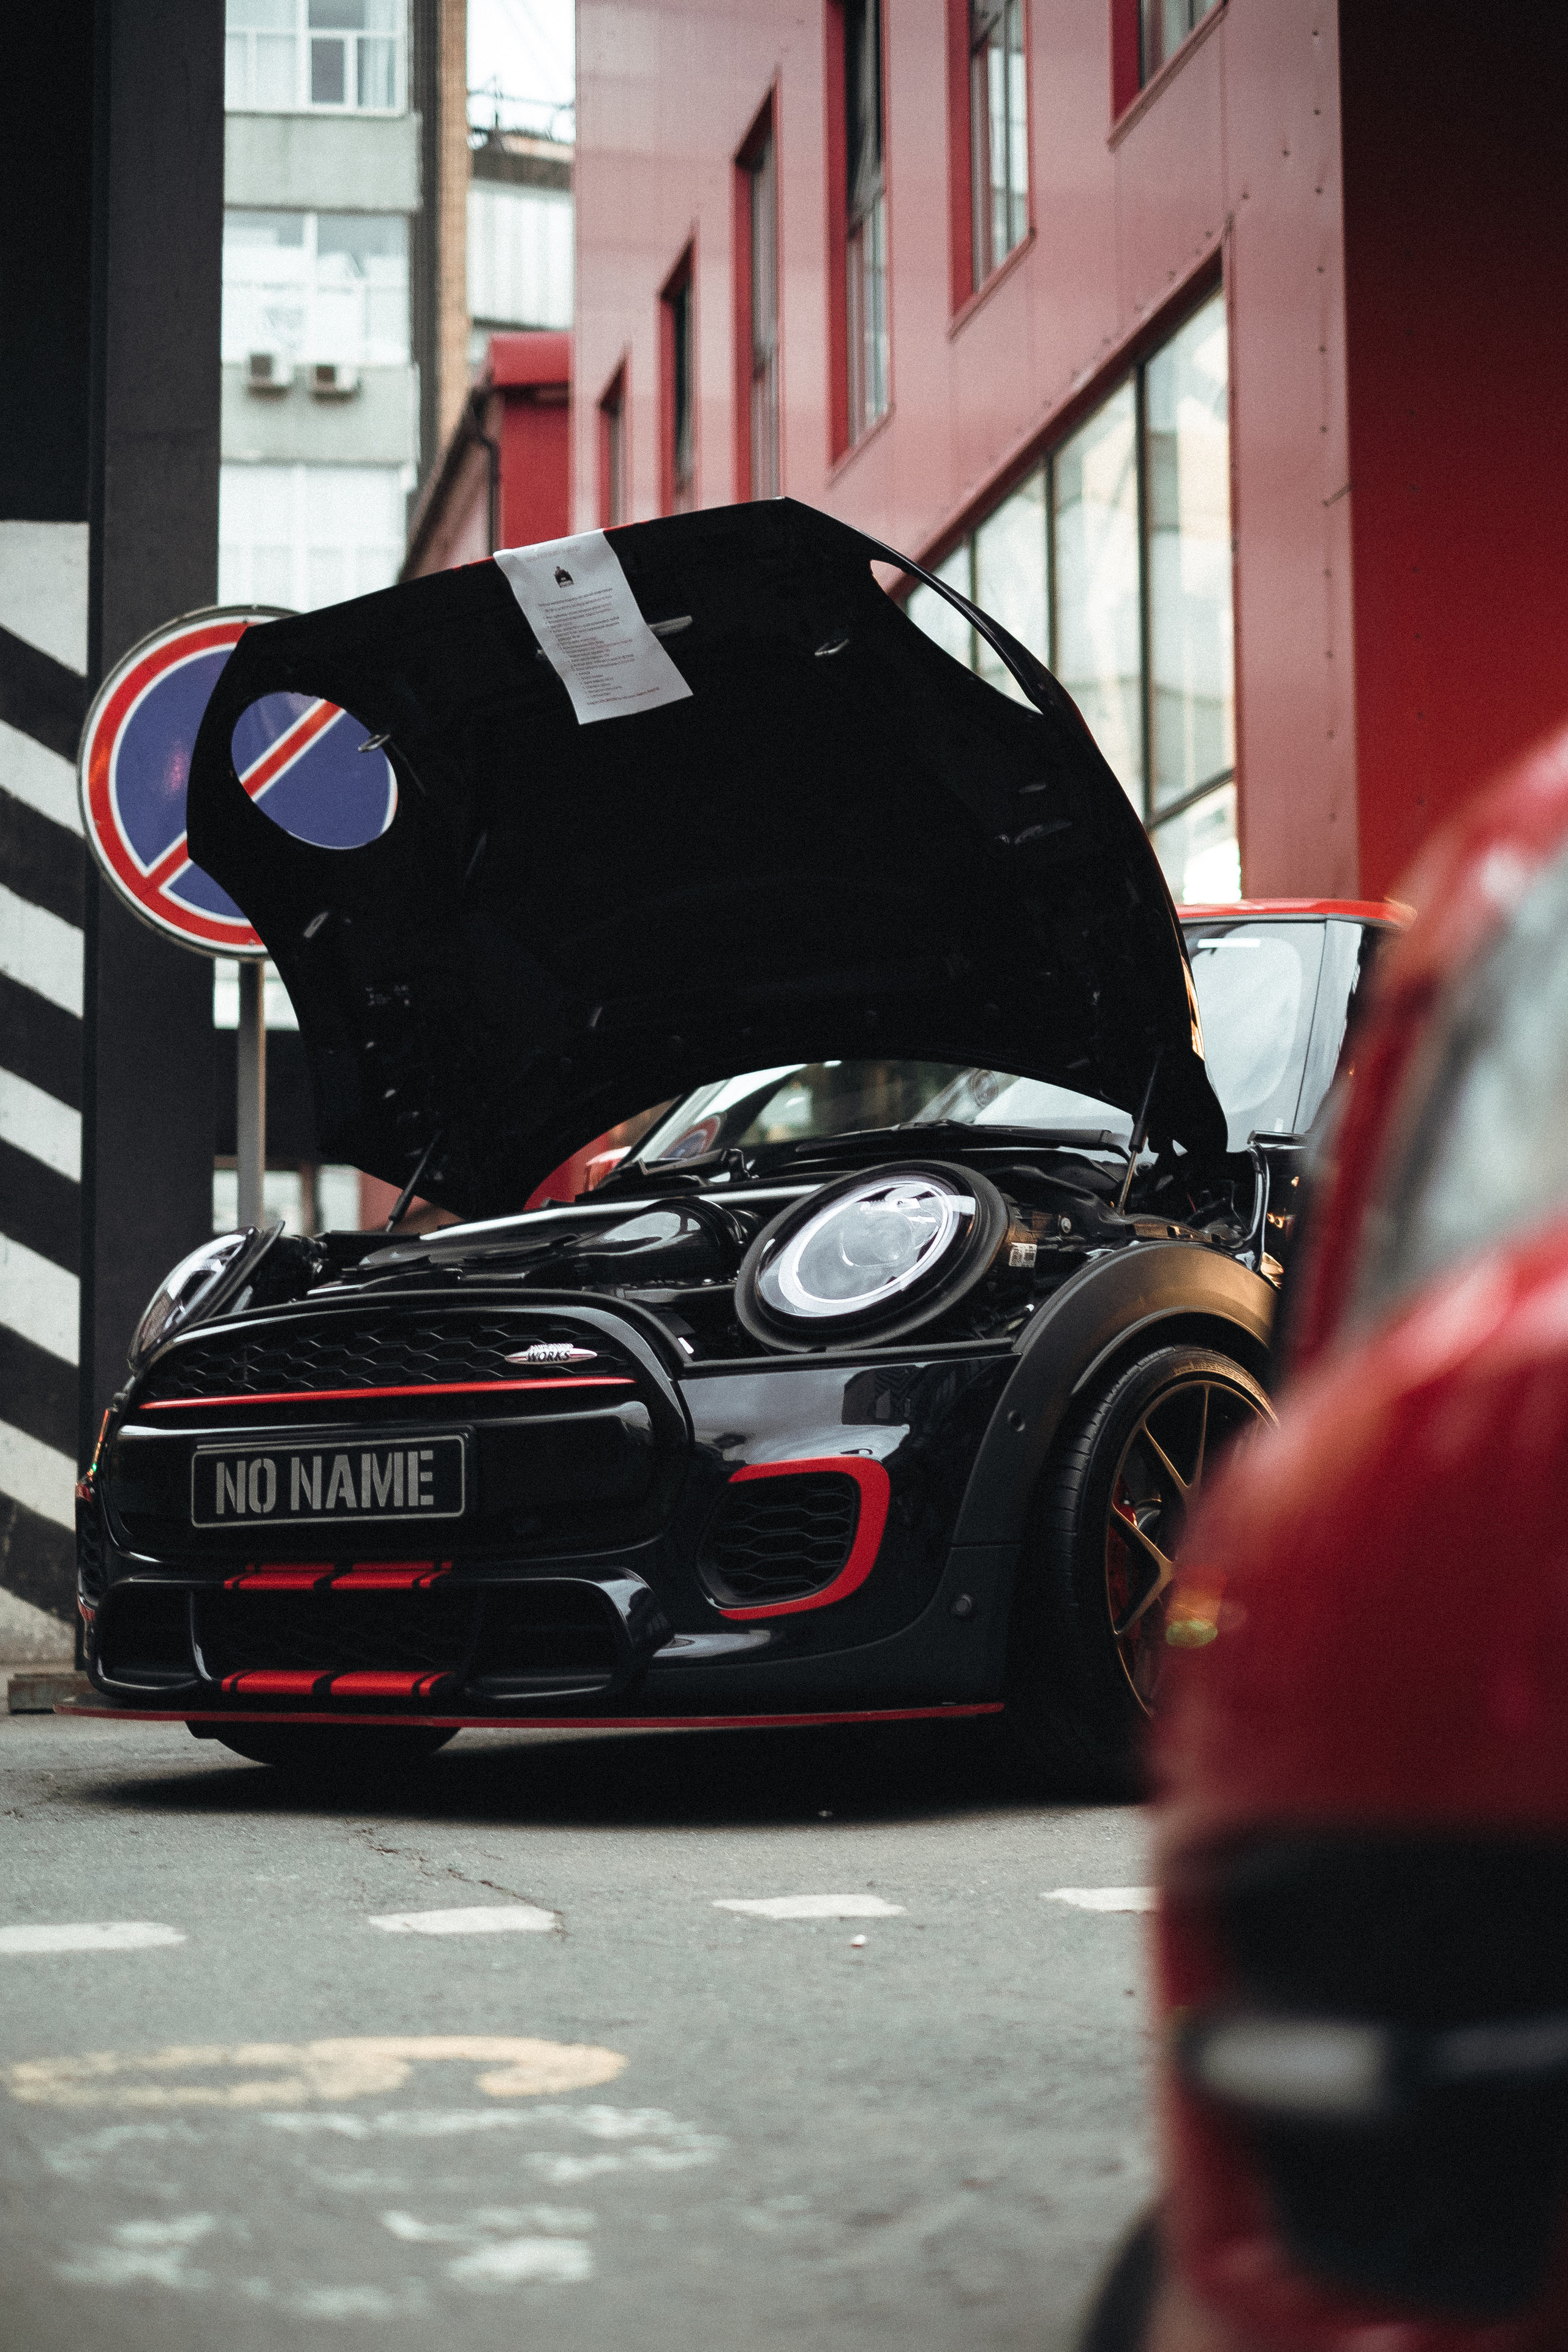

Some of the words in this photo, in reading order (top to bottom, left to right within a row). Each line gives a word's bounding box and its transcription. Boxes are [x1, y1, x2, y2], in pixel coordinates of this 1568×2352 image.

[527, 1351, 570, 1362] WORKS
[216, 1458, 276, 1514] NO
[291, 1450, 434, 1510] NAME
